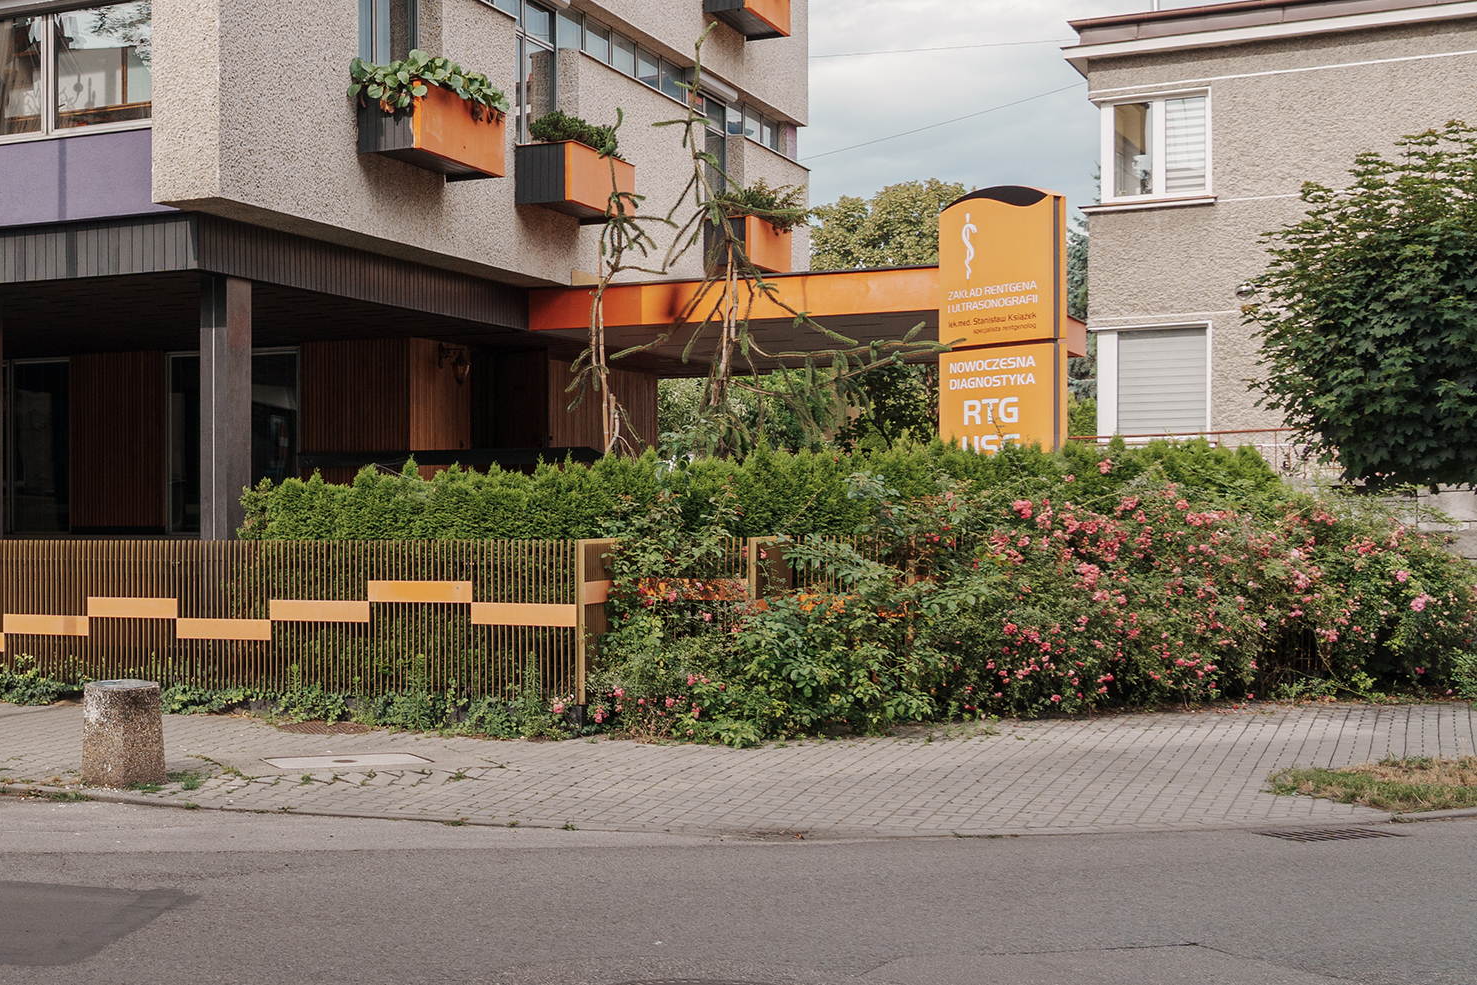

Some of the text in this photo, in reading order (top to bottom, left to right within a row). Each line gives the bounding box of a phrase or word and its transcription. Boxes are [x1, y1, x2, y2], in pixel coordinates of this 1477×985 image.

[948, 280, 1038, 301] ZAKŁAD RENTGENA
[951, 294, 1038, 313] ULTRASONOGRAFII
[949, 356, 1036, 374] NOWOCZESNA
[949, 373, 1036, 390] DIAGNOSTYKA
[963, 397, 1019, 426] RTG
